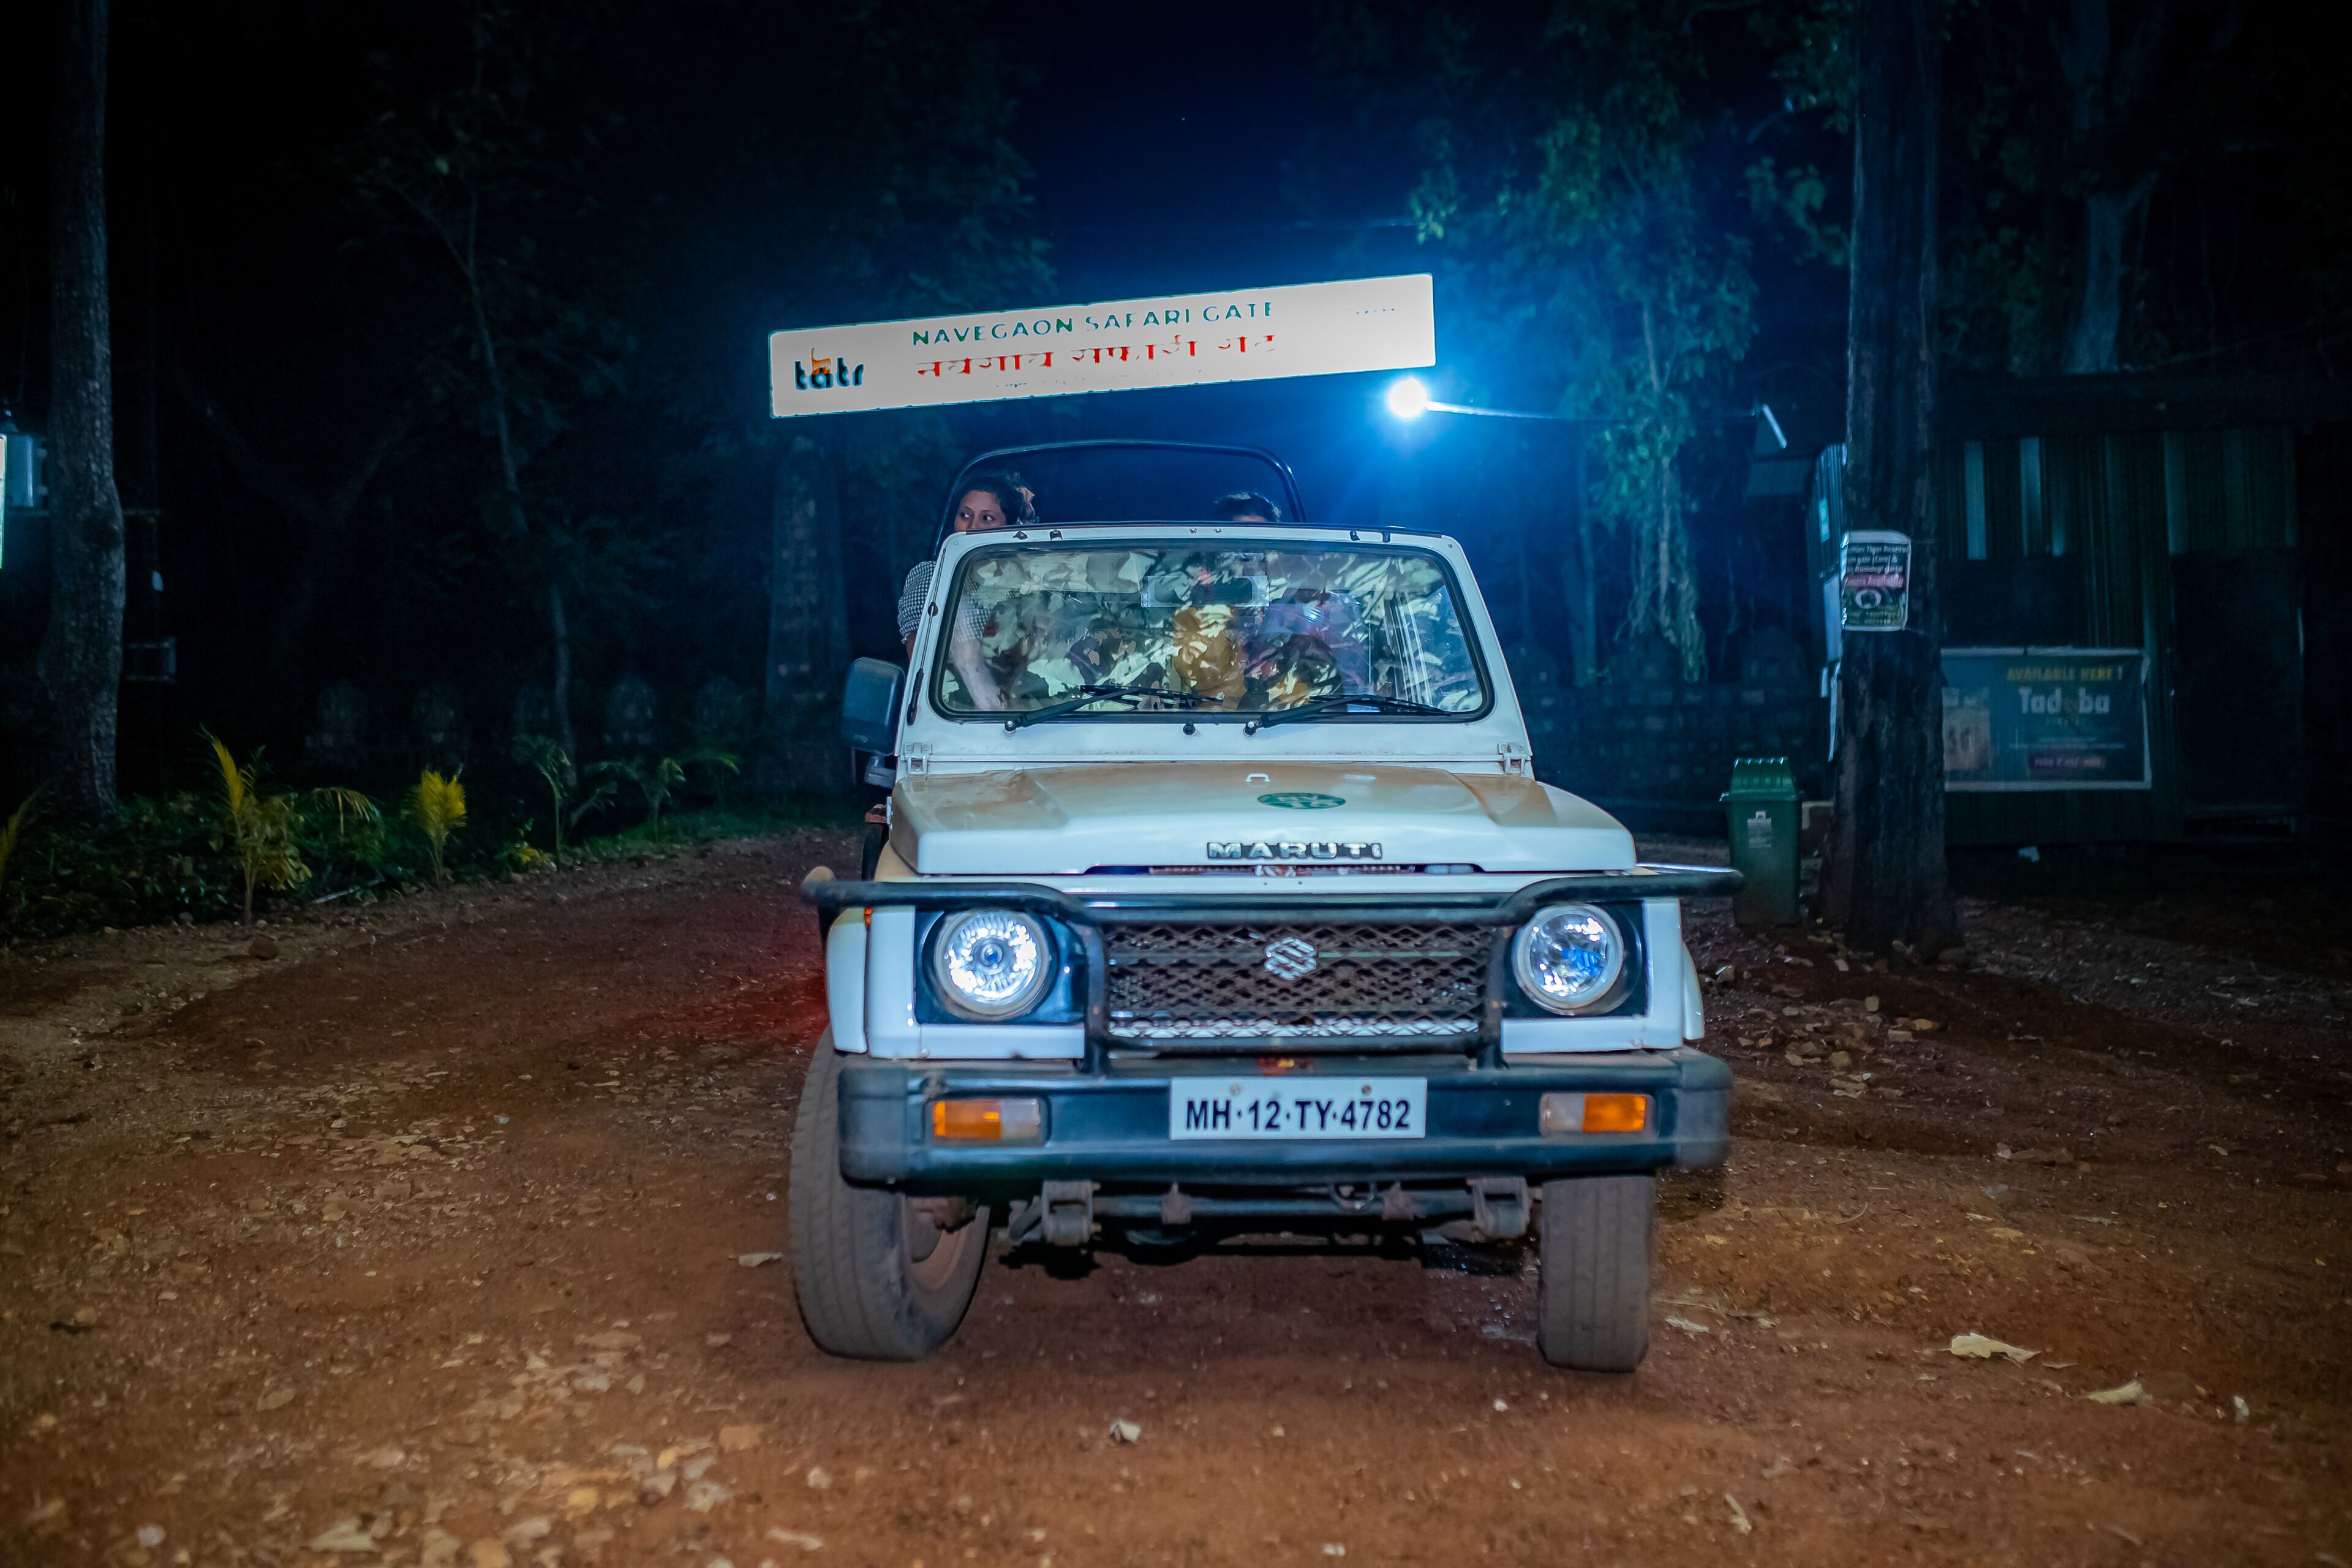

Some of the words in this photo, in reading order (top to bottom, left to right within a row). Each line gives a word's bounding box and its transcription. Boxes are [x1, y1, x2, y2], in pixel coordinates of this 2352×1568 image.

[913, 317, 1073, 346] NAVEGAON
[1085, 308, 1190, 331] SAFARI
[1202, 301, 1273, 322] GATE
[794, 357, 864, 390] tatr
[2019, 685, 2111, 715] Tadba
[1207, 842, 1382, 859] MARUTI
